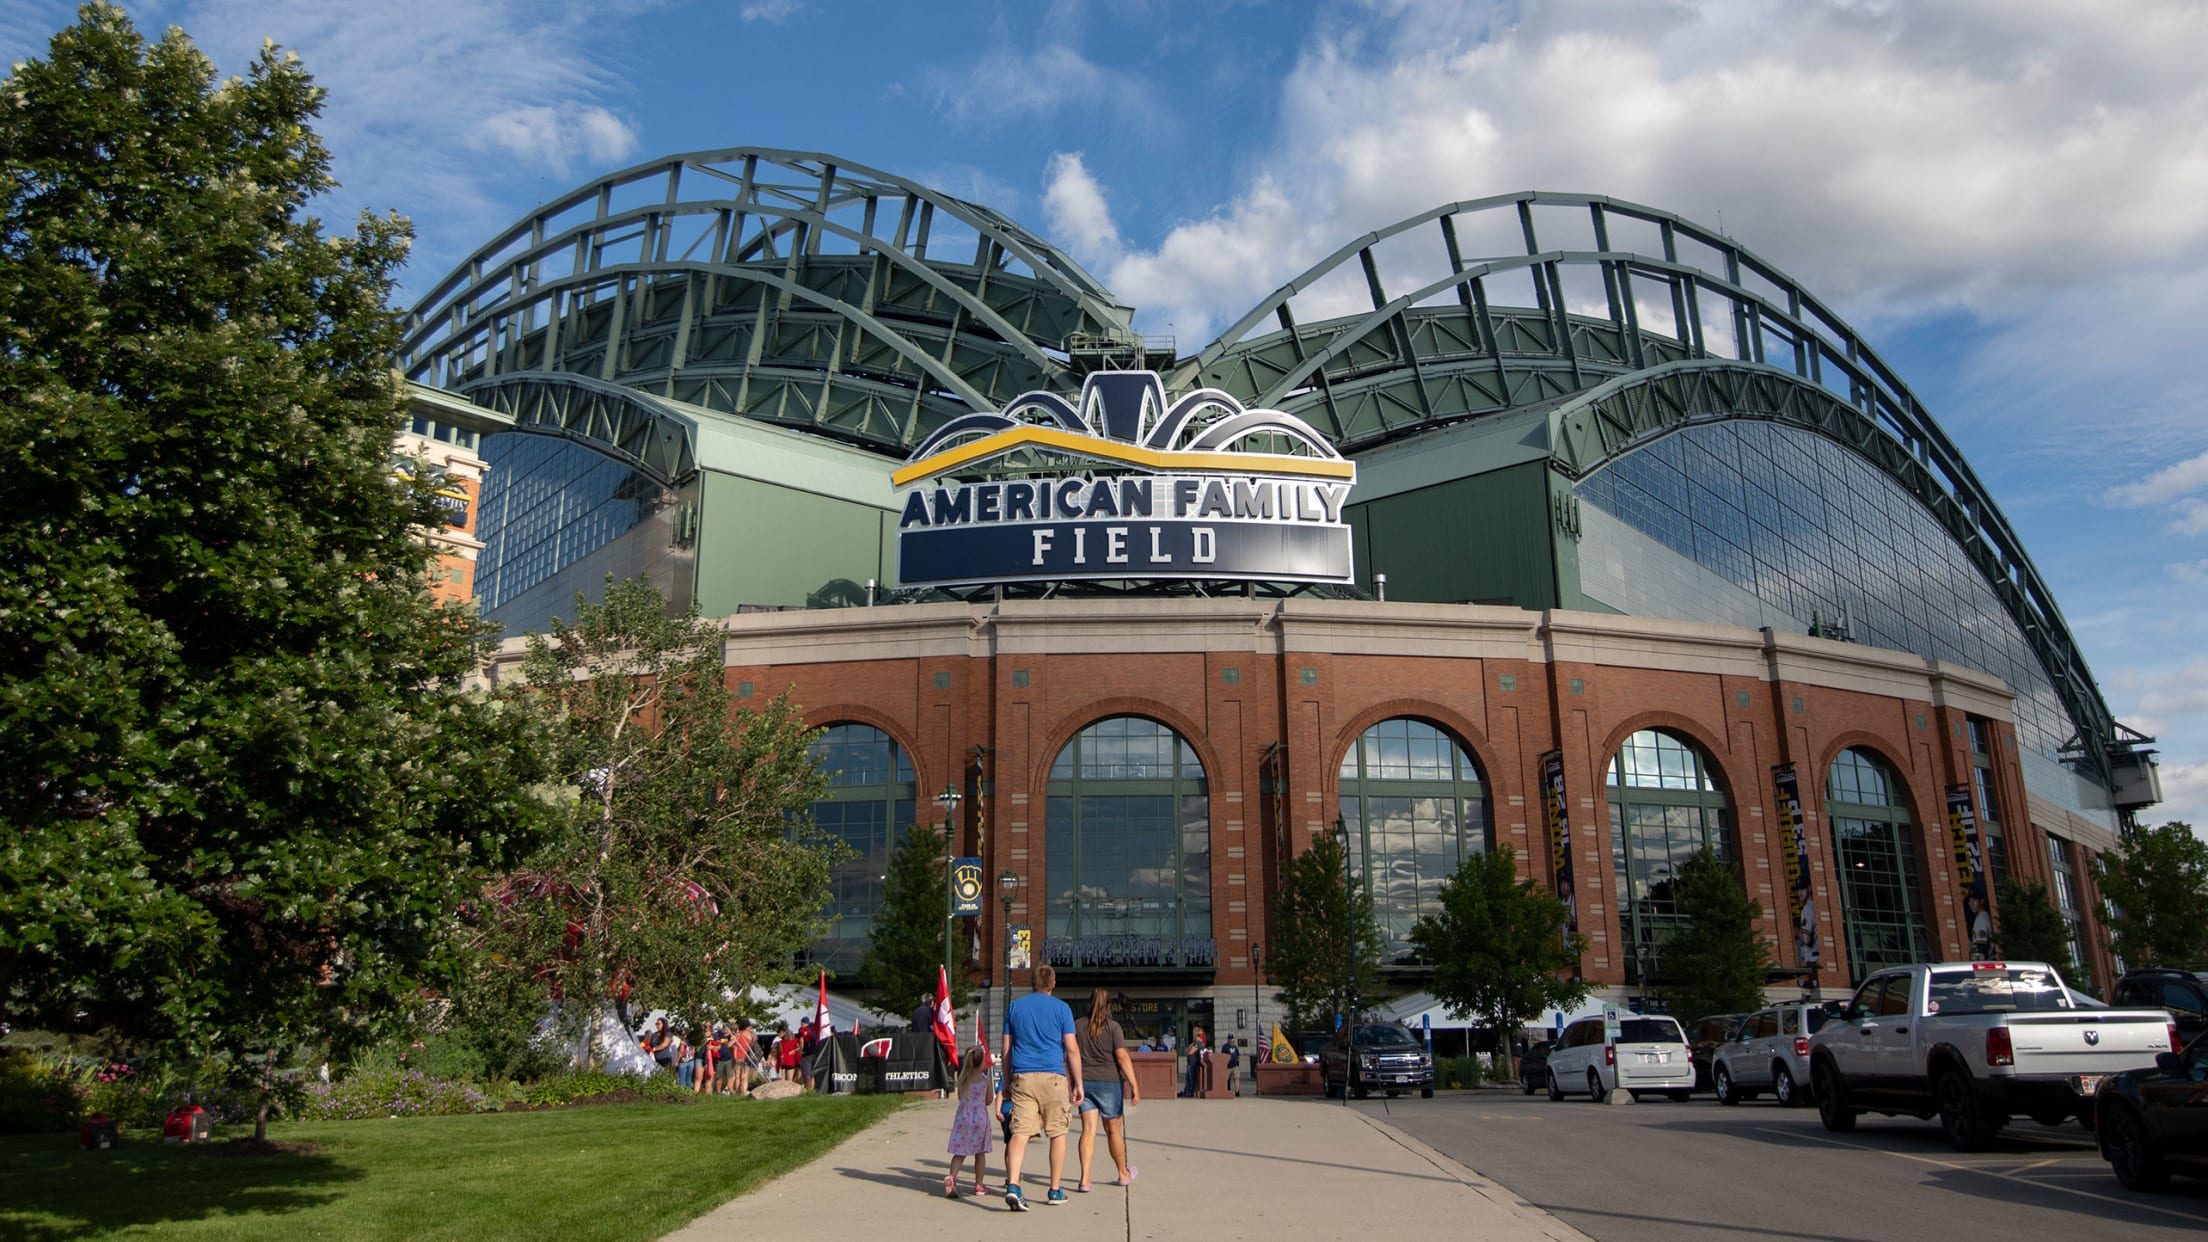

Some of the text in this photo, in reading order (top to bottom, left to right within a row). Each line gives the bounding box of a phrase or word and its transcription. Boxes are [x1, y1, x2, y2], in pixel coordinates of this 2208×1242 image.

[900, 479, 1346, 527] AMERICAN FAMILY
[1032, 527, 1217, 565] FIELD
[1549, 787, 1566, 872] WONG
[1788, 801, 1807, 855] 53 P
[1957, 805, 1983, 872] 22 OF
[1040, 937, 1216, 960] BREWERS TEAM STORE
[1131, 1002, 1159, 1013] STORE
